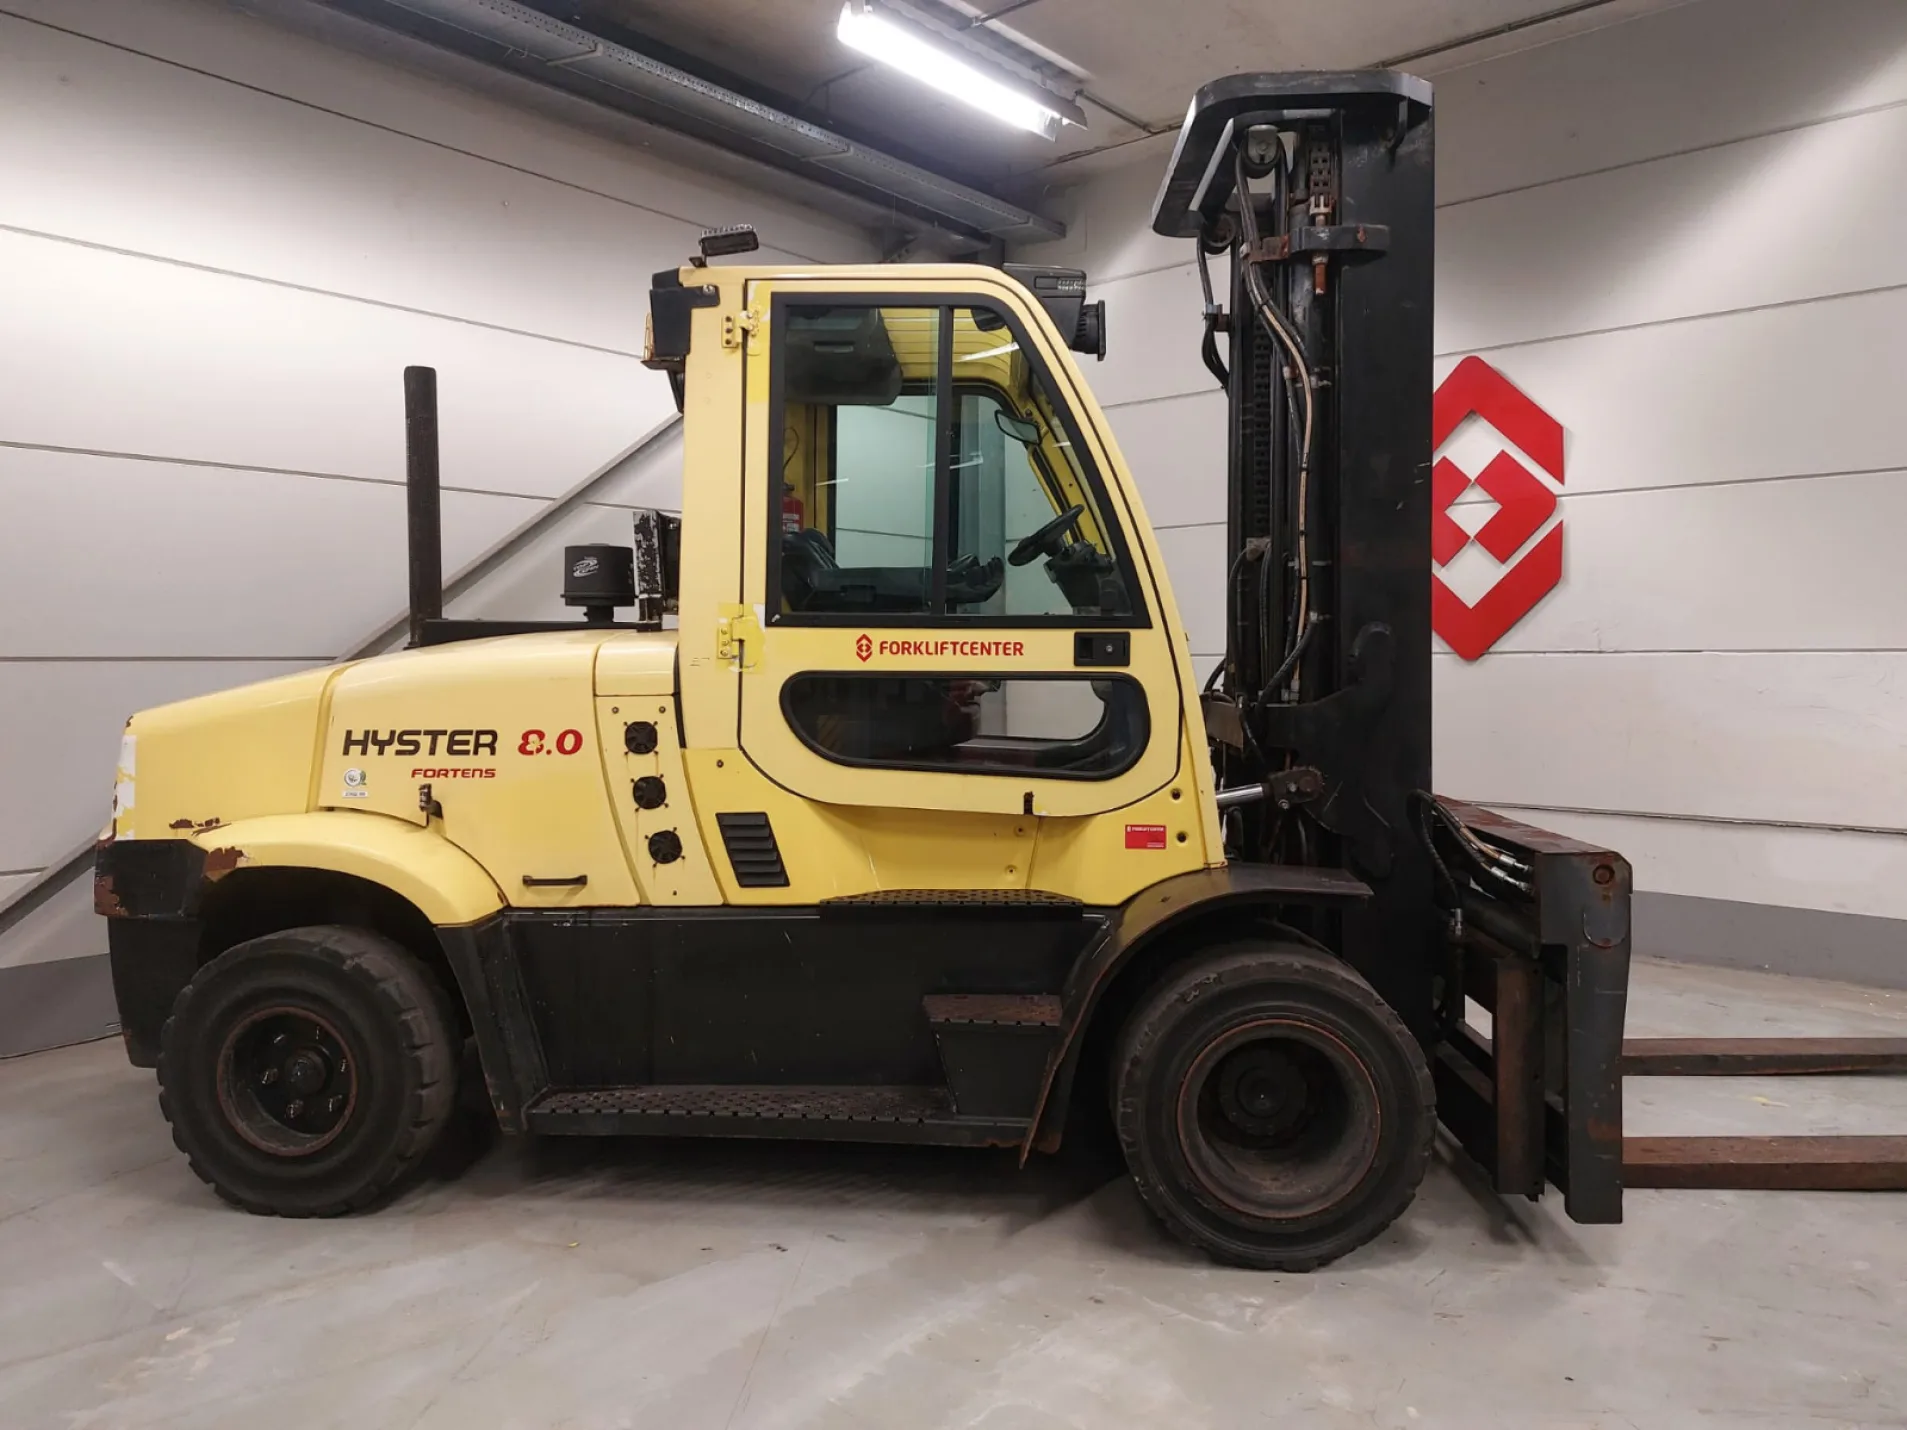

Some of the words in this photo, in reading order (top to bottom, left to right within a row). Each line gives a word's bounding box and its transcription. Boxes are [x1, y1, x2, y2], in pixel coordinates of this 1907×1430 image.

[879, 641, 1024, 656] FORKLIFTCENTER
[342, 730, 498, 756] HYSTER
[518, 729, 583, 755] 8.0
[411, 768, 496, 778] FORTENS
